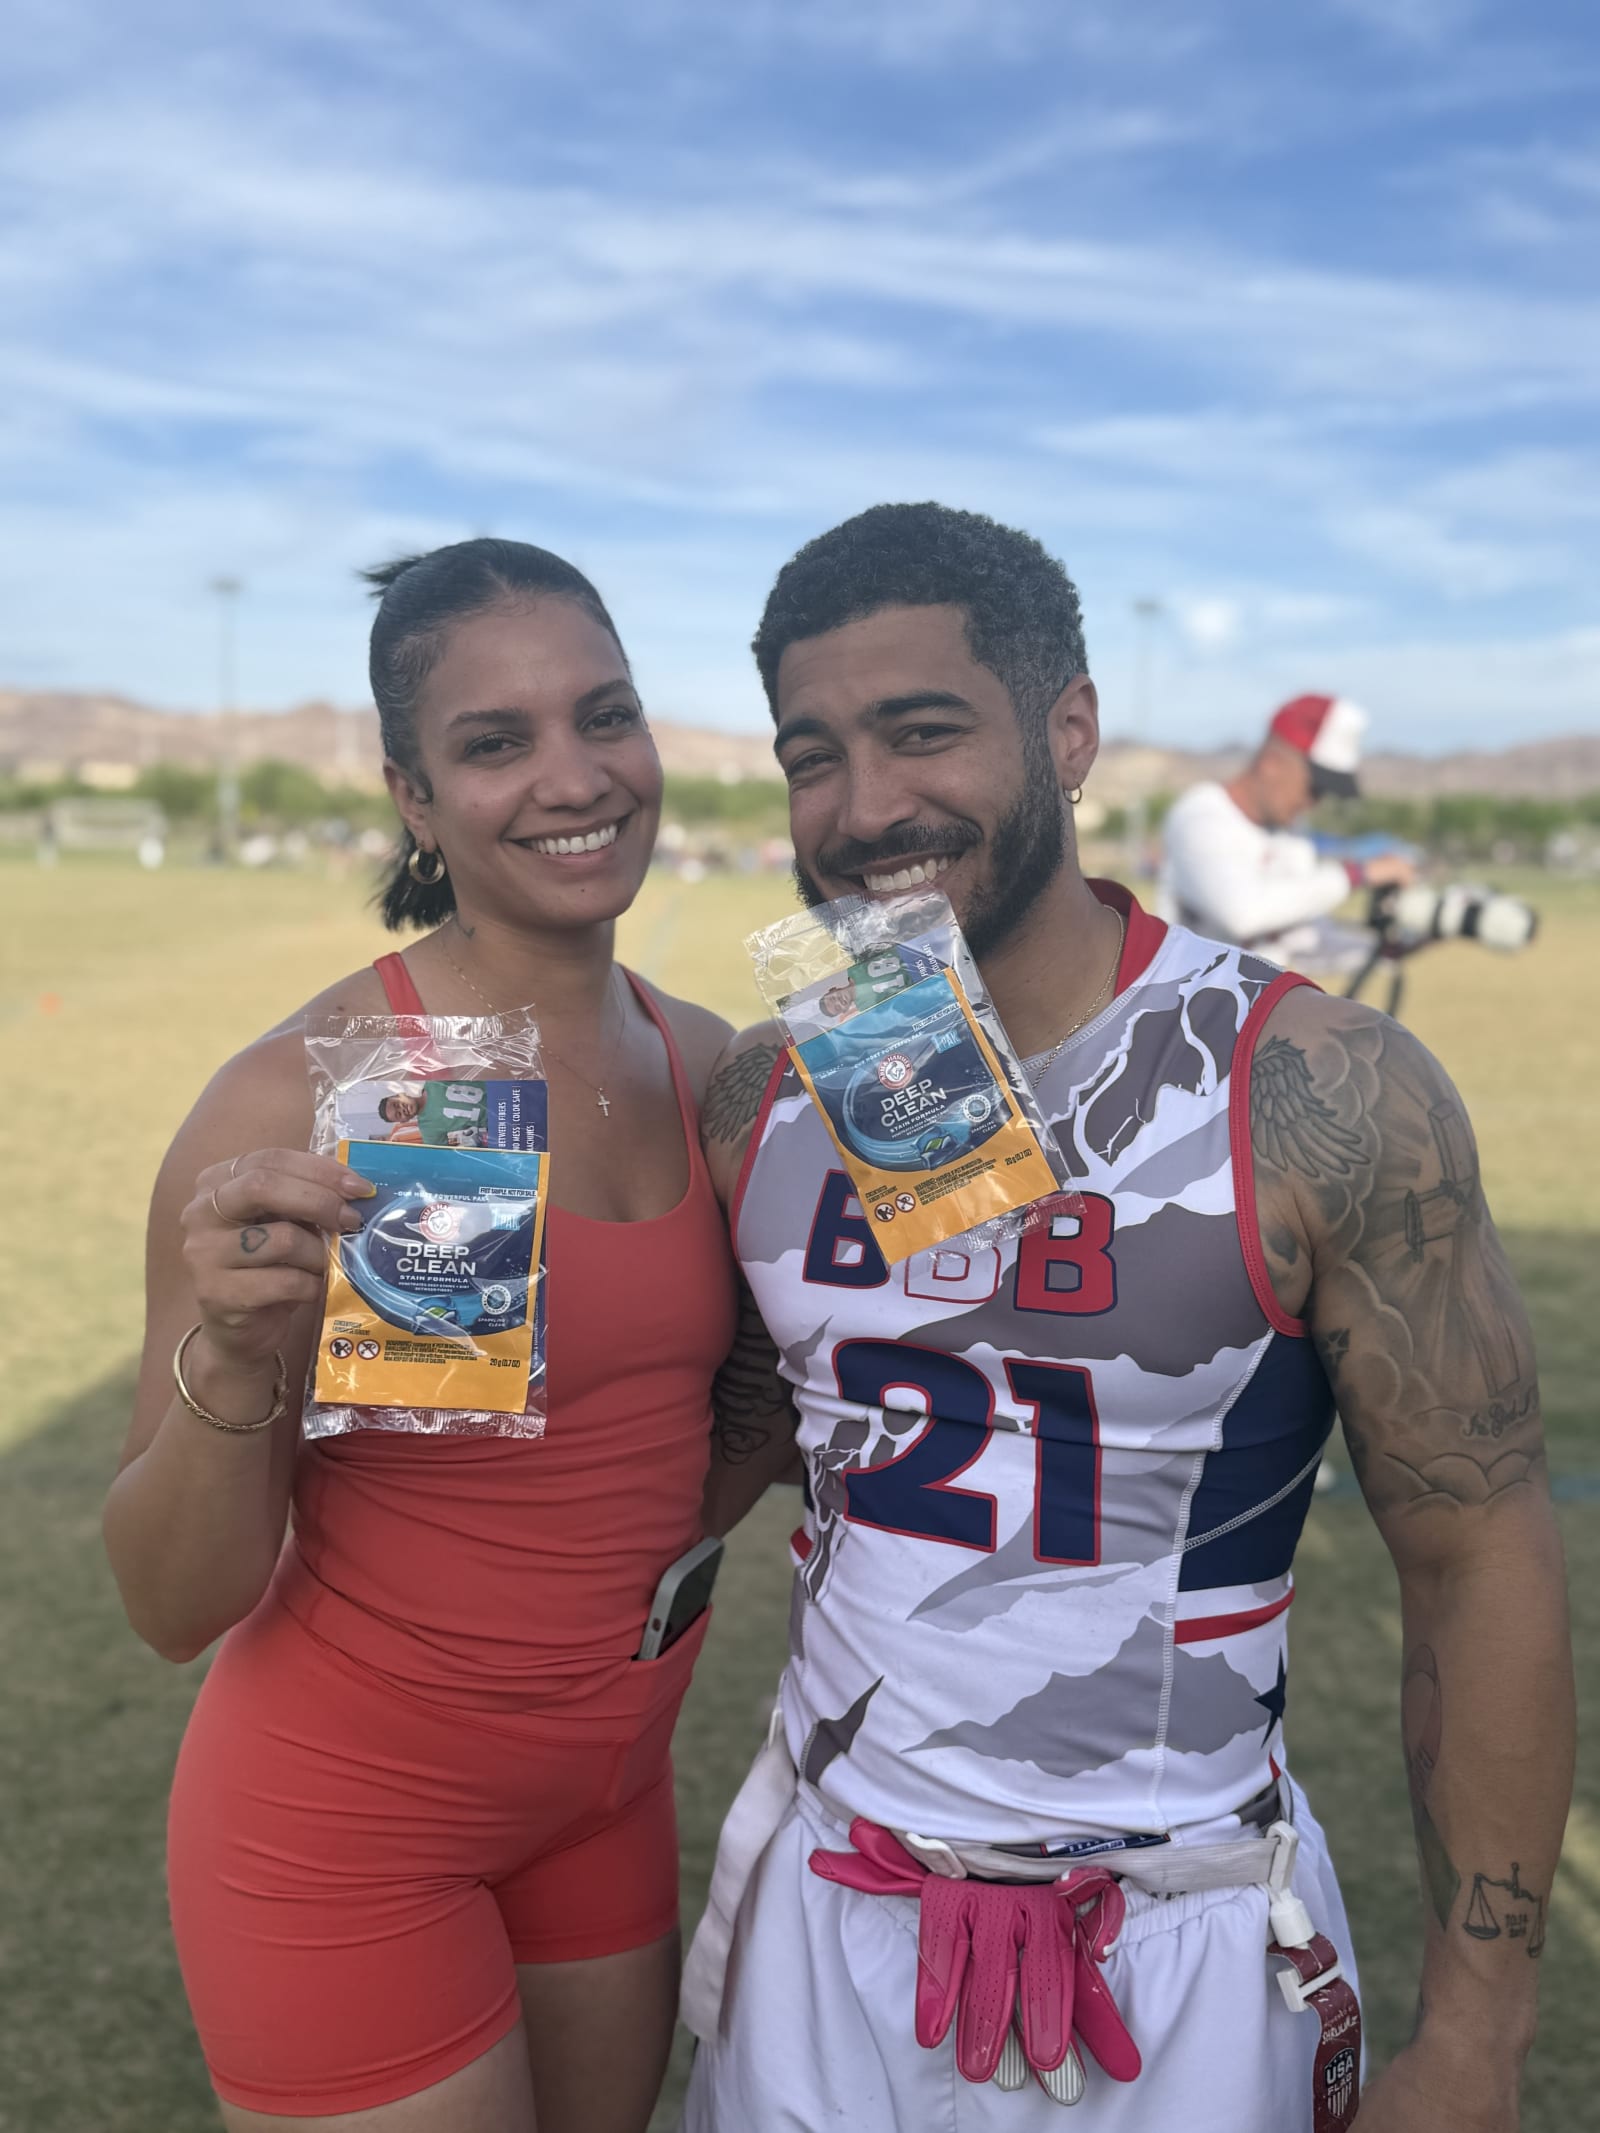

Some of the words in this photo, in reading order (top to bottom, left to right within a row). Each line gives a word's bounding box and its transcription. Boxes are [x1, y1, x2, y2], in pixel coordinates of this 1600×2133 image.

[512, 1088, 521, 1103] SAFE
[880, 1079, 932, 1112] DEEP
[497, 1101, 507, 1121] FIBERS
[512, 1104, 521, 1122] COLOR
[881, 1087, 947, 1127] CLEAN
[889, 1121, 910, 1133] STAIN
[911, 1104, 946, 1122] FORMULA
[497, 1121, 507, 1148] BETWEEN
[512, 1125, 521, 1142] MESS
[434, 1193, 471, 1201] POWERFUL
[406, 1243, 470, 1260] DEEP
[396, 1257, 476, 1276] CLEAN
[832, 1337, 1102, 1567] 21
[1326, 2055, 1354, 2085] USA
[1327, 2073, 1353, 2096] FLAG
